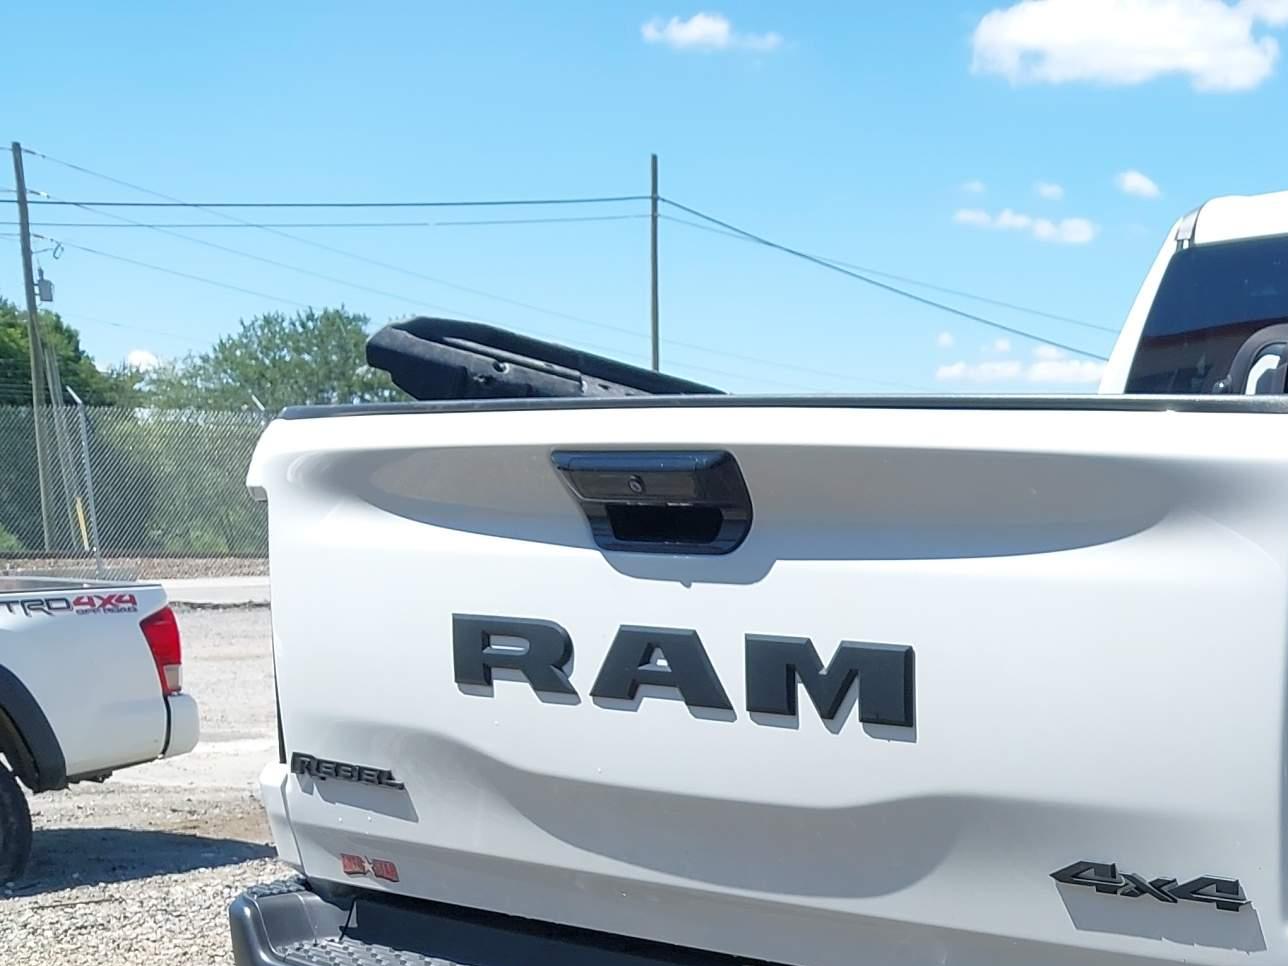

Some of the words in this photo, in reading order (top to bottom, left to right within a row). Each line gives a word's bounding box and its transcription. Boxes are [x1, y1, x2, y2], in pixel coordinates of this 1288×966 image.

[0, 597, 73, 617] TRD
[452, 613, 914, 727] RAM
[291, 752, 406, 791] REBEL
